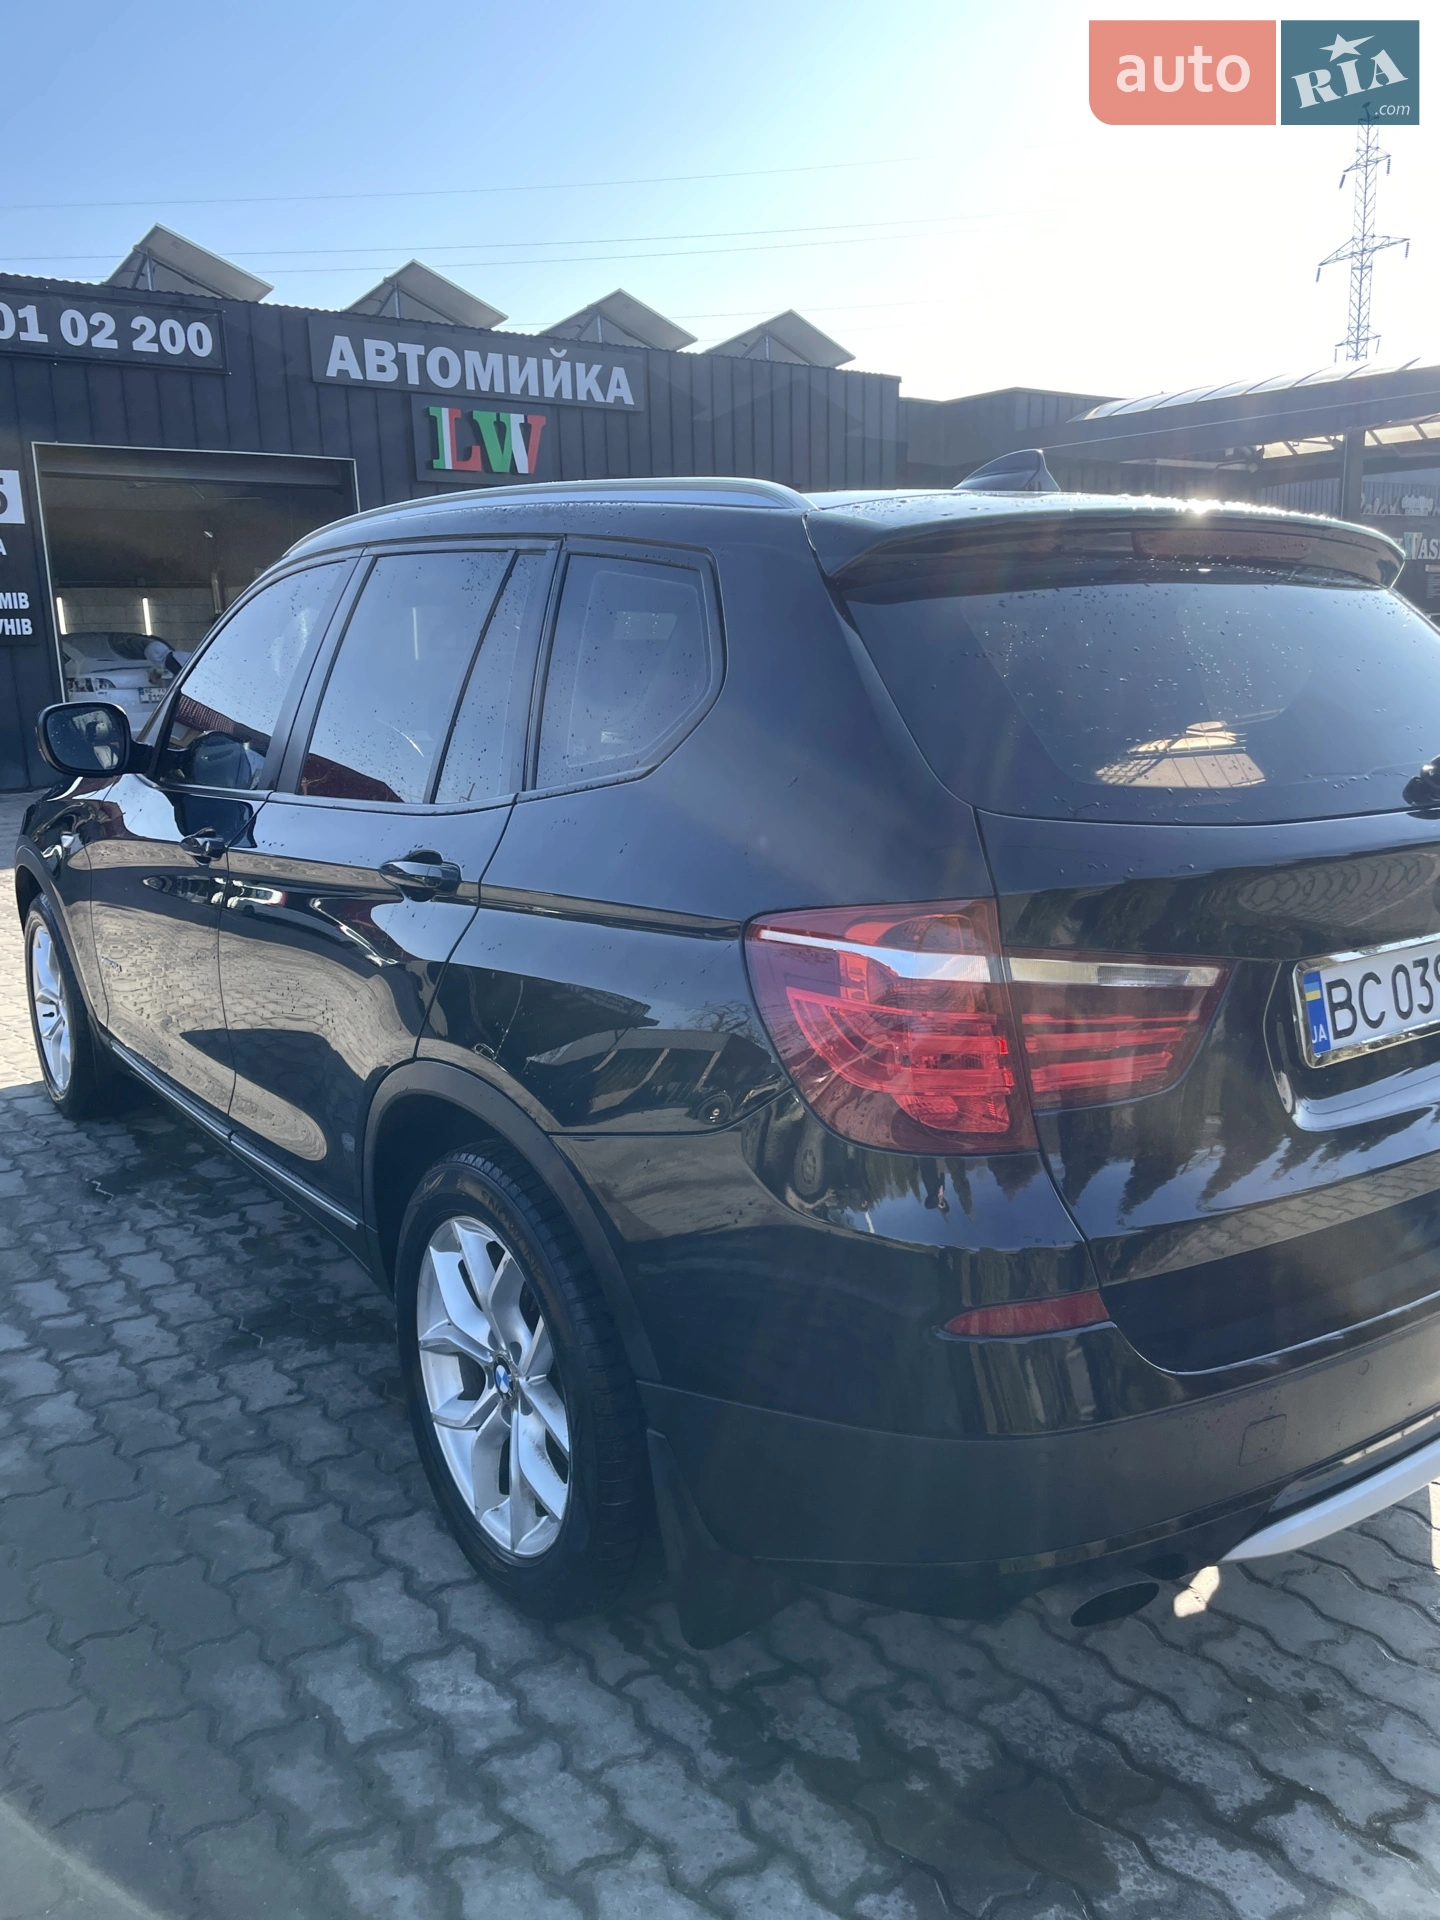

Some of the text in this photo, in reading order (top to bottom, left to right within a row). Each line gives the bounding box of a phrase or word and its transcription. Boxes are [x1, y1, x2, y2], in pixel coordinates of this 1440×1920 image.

[59, 308, 119, 350] 02
[130, 315, 213, 357] 200
[325, 335, 636, 406] АВТОМИЙКА
[0, 618, 33, 636] НІВ
[1325, 971, 1386, 1040] BC
